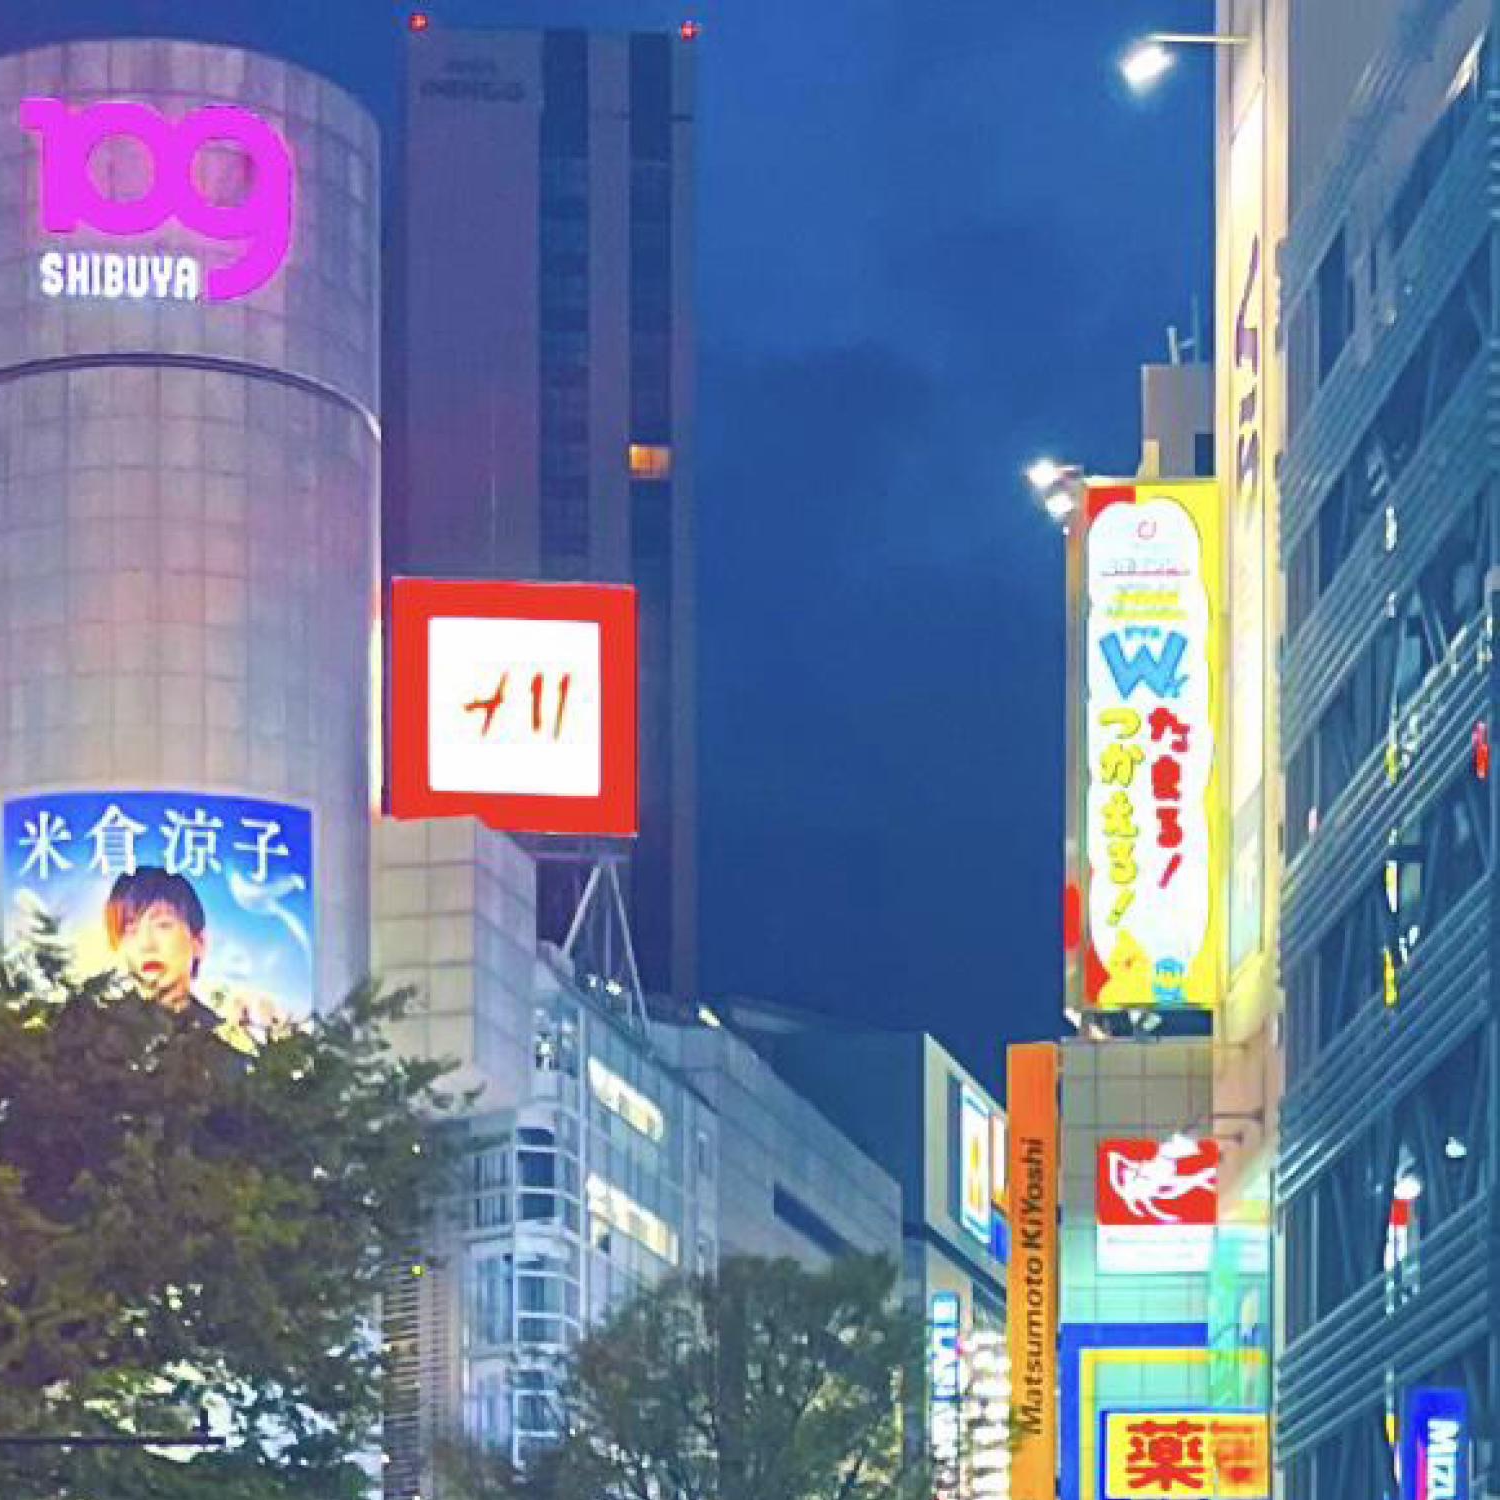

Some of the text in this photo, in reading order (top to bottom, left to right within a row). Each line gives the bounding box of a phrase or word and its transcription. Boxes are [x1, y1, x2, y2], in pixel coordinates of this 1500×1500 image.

[20, 97, 293, 301] 109
[39, 251, 199, 300] SHIBUYA
[18, 804, 290, 882] 米倉涼子
[1021, 1138, 1045, 1435] Matsumoto KiYoshi
[1126, 1420, 1205, 1491] 薬
